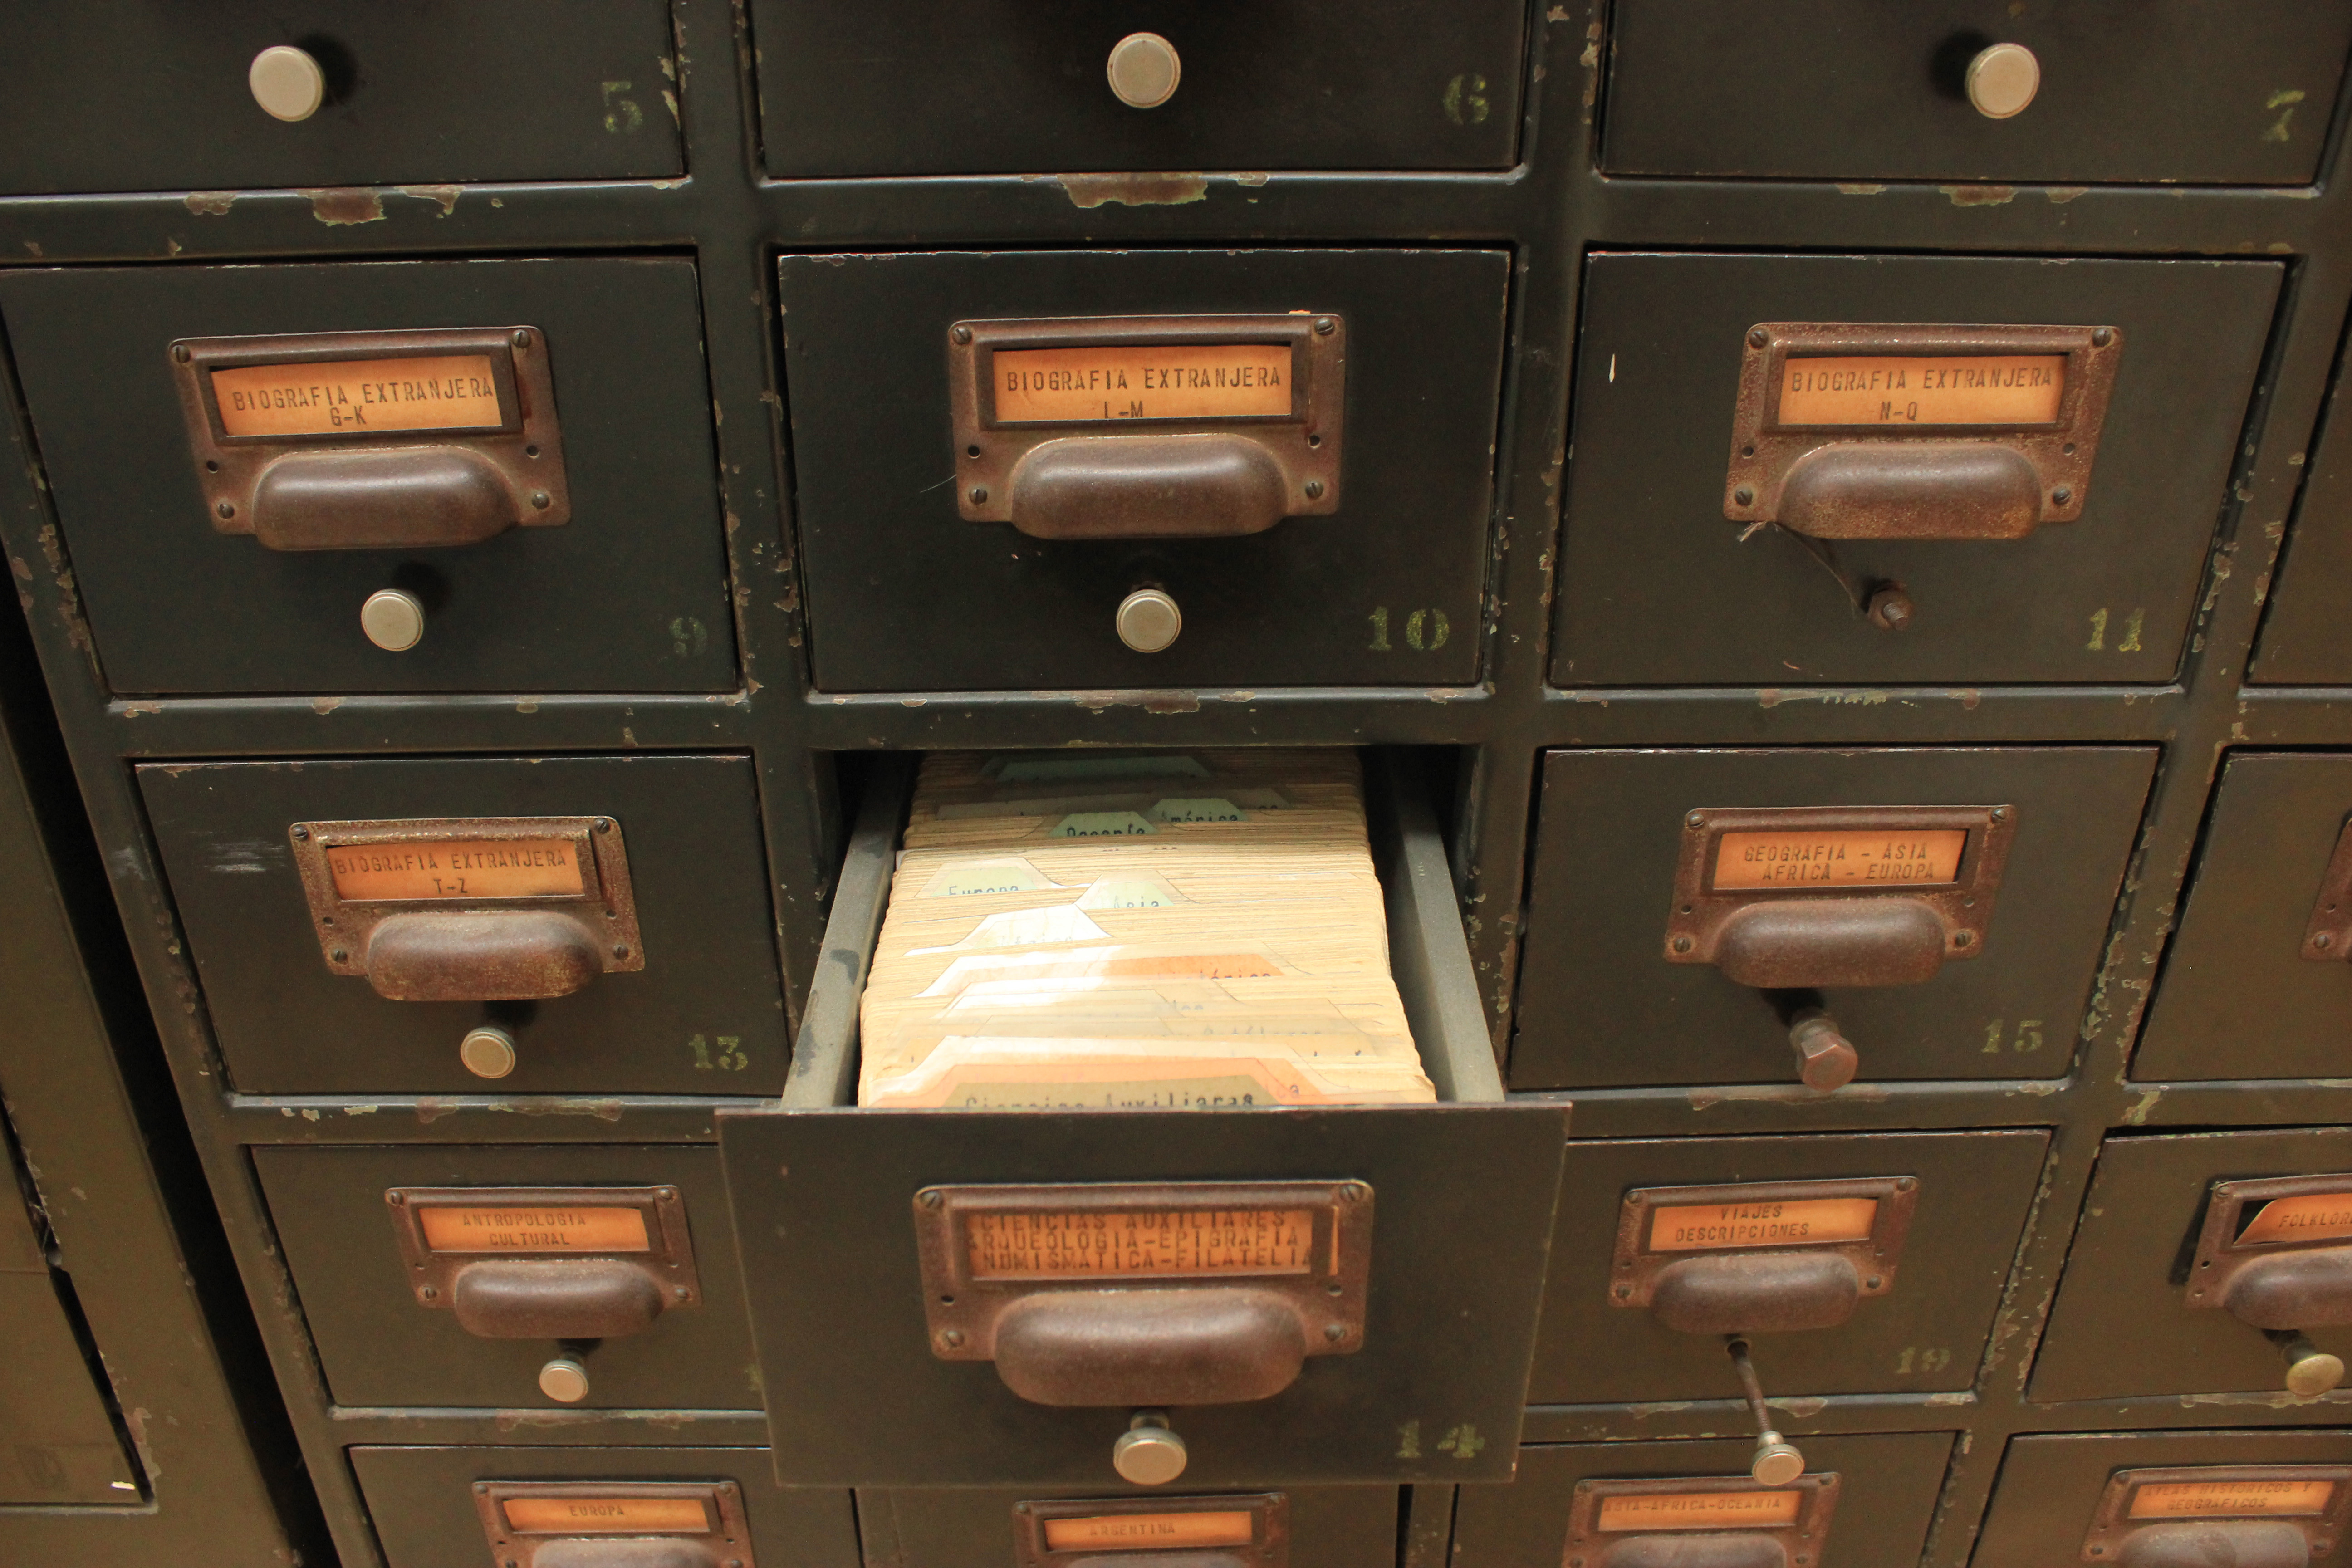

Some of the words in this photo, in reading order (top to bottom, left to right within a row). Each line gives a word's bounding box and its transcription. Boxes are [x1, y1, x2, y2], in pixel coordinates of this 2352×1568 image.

[602, 81, 643, 133] 5
[1443, 74, 1490, 126] 6
[2264, 91, 2305, 142] 7
[1007, 369, 1128, 392] BIOGRAFIA
[1144, 366, 1280, 389] EXTRANJERA
[1791, 370, 1906, 392] BIOGRAFIA
[1923, 367, 2052, 390] EXTRANJERA
[232, 385, 348, 412] BIOGRAFIA
[362, 377, 494, 405] EXTRANJERA
[330, 405, 367, 427] G-K
[1103, 400, 1143, 419] L-M
[1880, 401, 1918, 422] N-Q
[668, 616, 708, 658] 9
[1368, 606, 1450, 651] 10
[2084, 608, 2146, 652] 11
[335, 853, 438, 874] BIOGRAFIA
[453, 849, 567, 870] EXTRANJERA
[1744, 844, 1846, 862] GEOGRAFIA
[1882, 843, 1928, 860] ASIA
[1762, 863, 1831, 881] AFRICA
[1865, 862, 1935, 880] EUROPA
[433, 878, 469, 895] T-Z
[1980, 1019, 2043, 1053] 15
[688, 1034, 749, 1071] 13
[463, 1214, 586, 1226] ANTROPOLOGIA
[980, 1213, 1107, 1231] CIENCIAS
[1125, 1210, 1285, 1230] AUXILIARES
[1721, 1205, 1783, 1220] VIAJES
[2278, 1211, 2352, 1228] FOLKLOR
[490, 1232, 570, 1246] CULTURAL
[1676, 1223, 1810, 1242] DESCRIPCIONES
[1394, 1420, 1486, 1459] 14
[569, 1505, 625, 1517] EUROPA
[2167, 1497, 2268, 1511] GEOGRAFICOS
[1090, 1523, 1175, 1537] ARGENTINA
